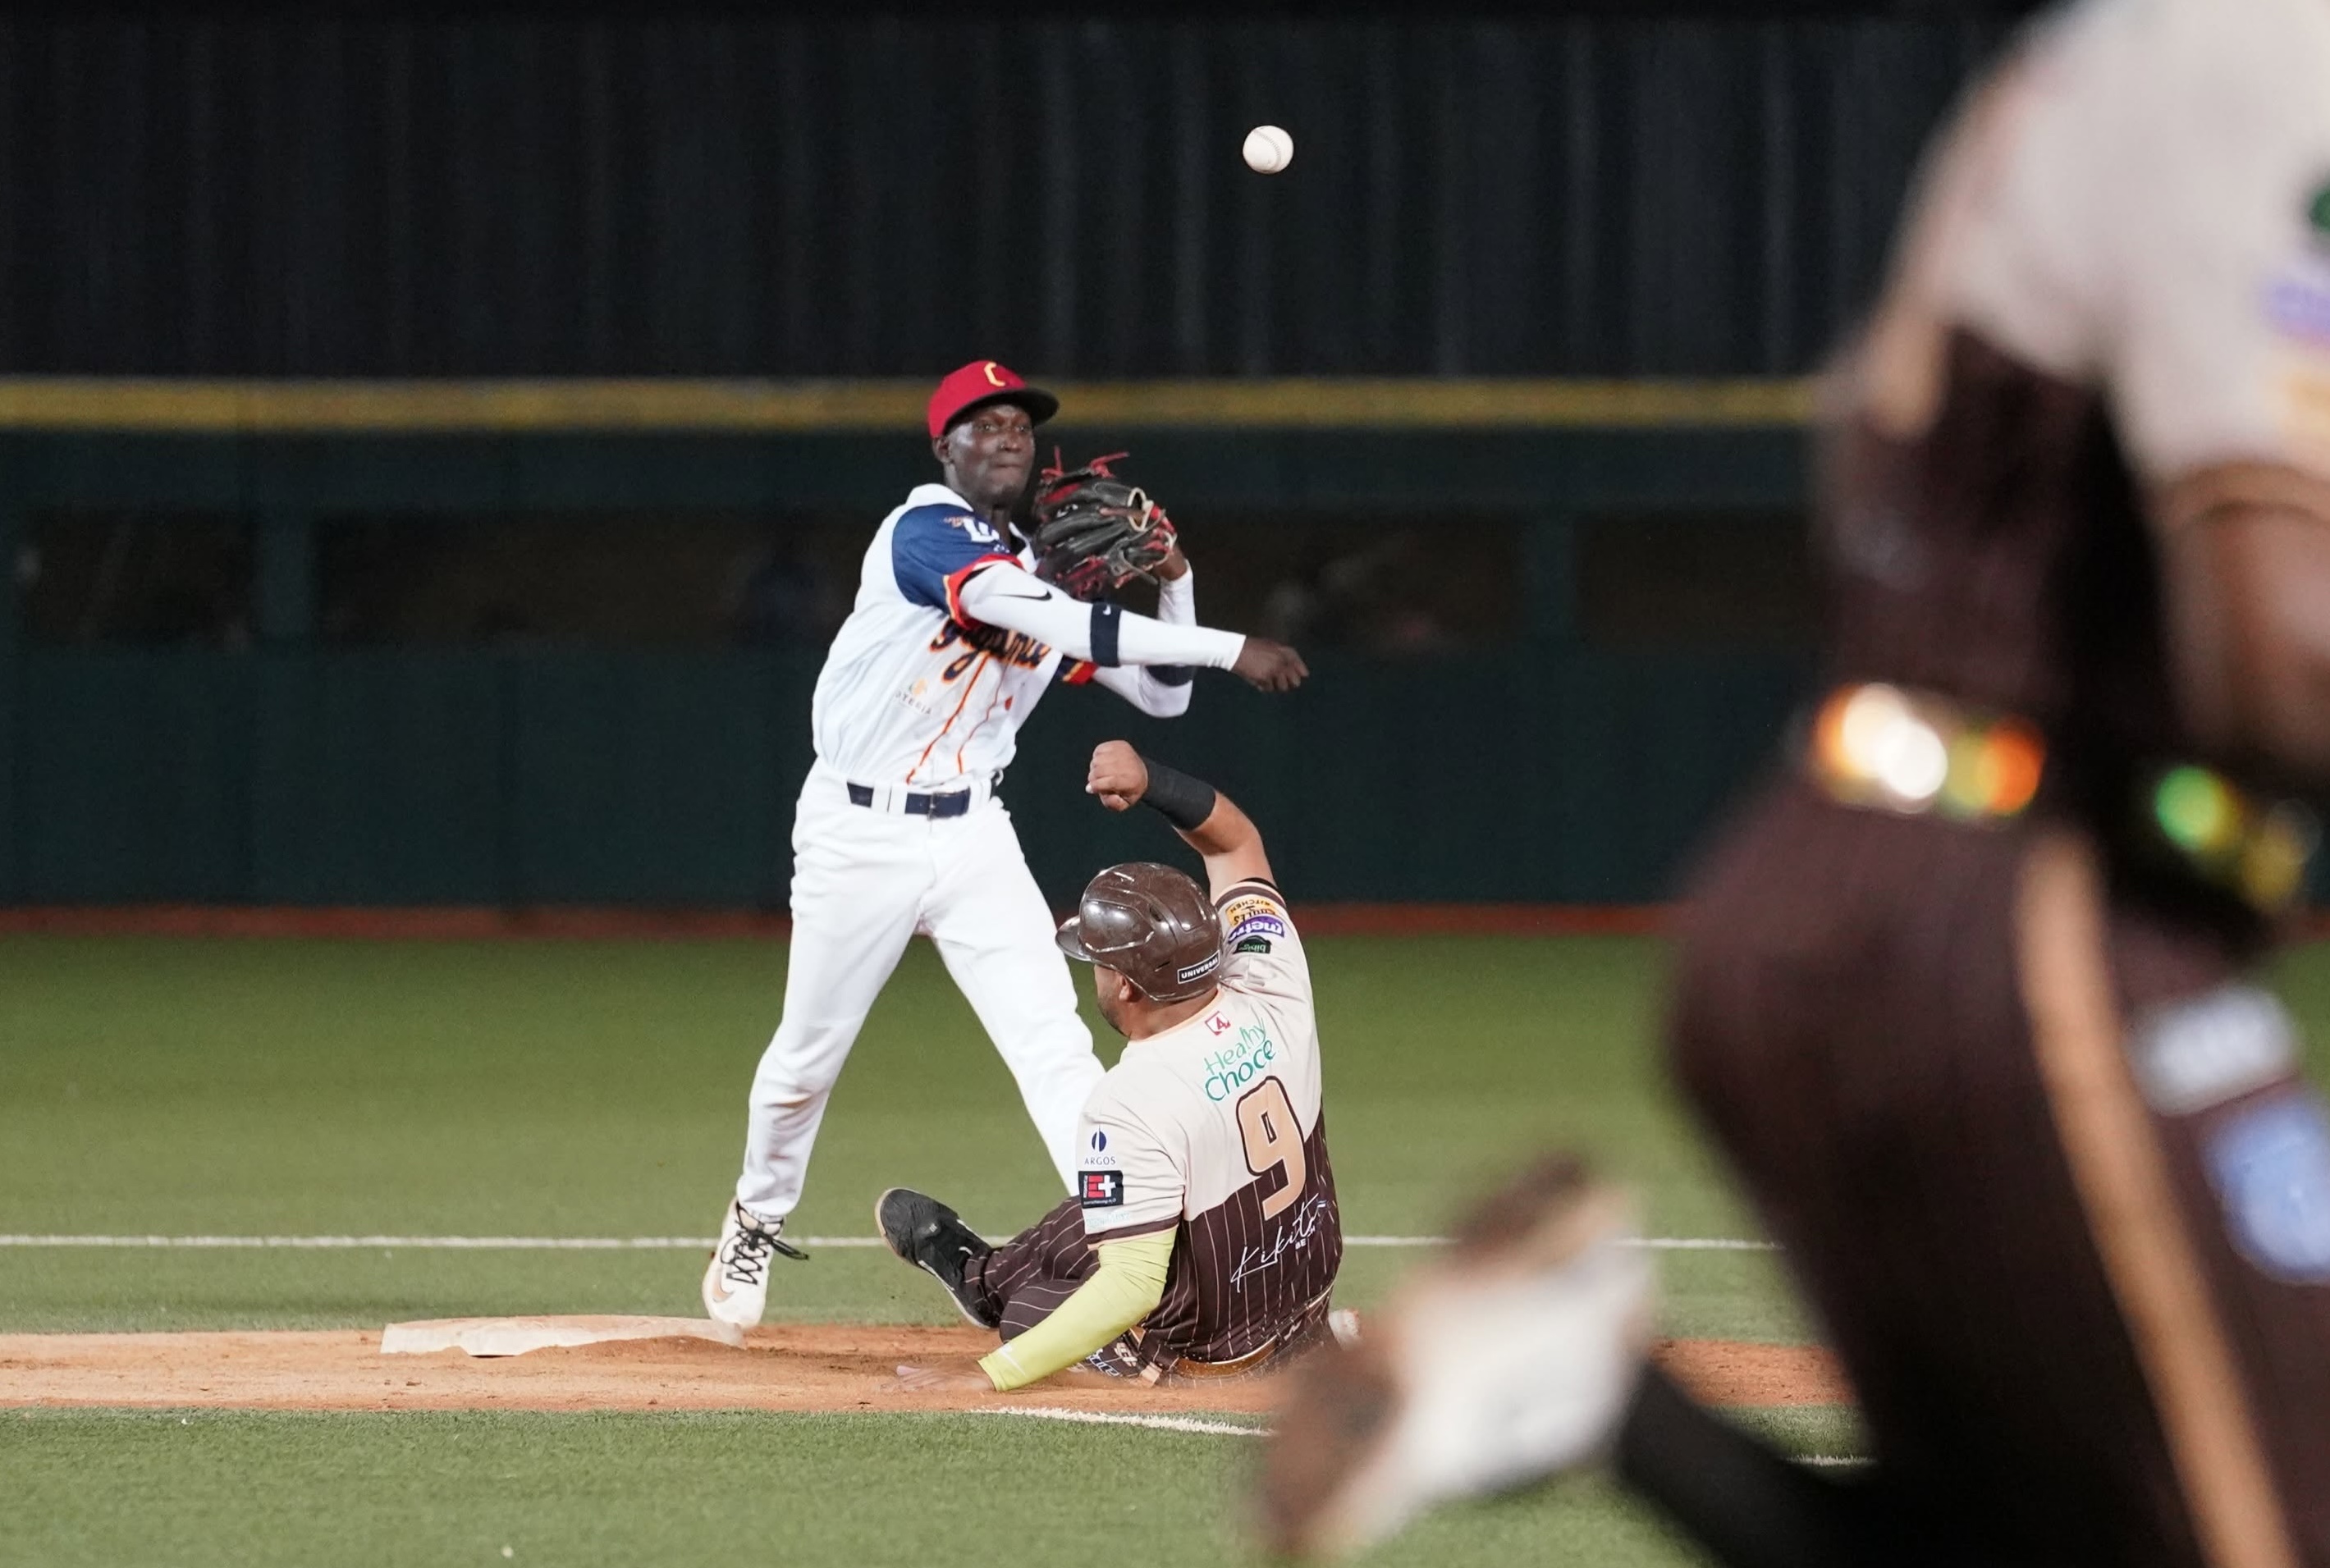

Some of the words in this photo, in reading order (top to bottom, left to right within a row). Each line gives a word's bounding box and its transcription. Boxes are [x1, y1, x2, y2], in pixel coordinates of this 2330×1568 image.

[983, 362, 1006, 387] C
[1084, 1155, 1116, 1165] ARGOS
[1236, 1076, 1307, 1222] 9
